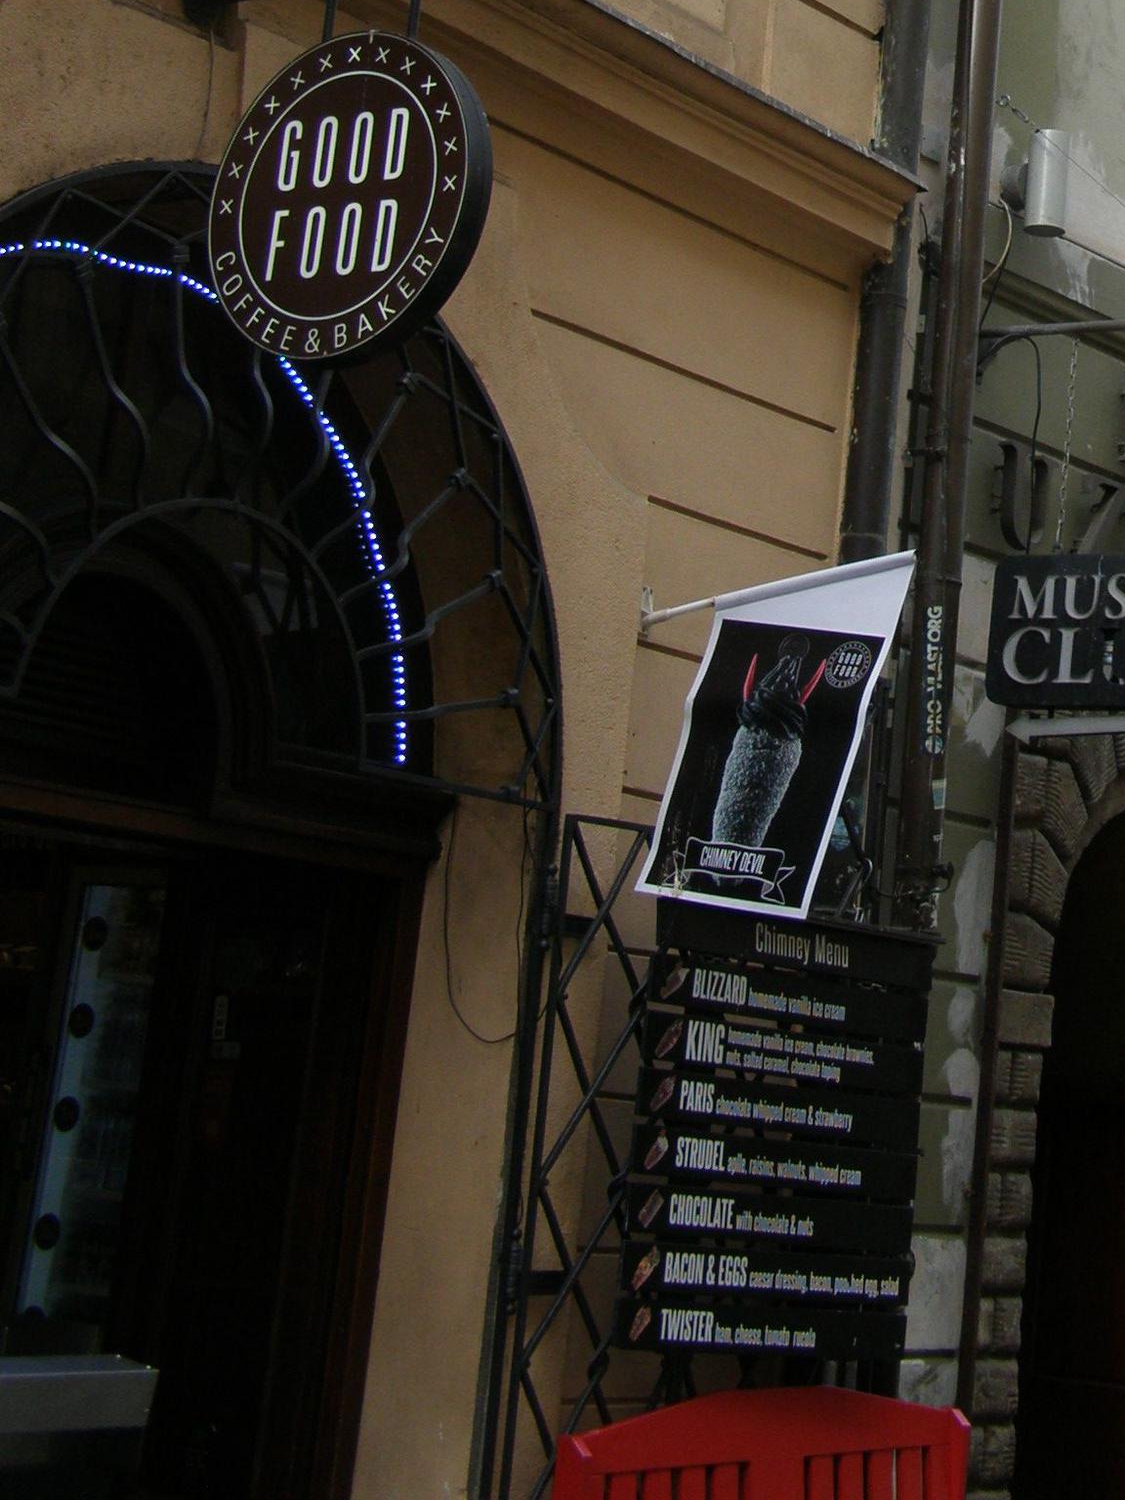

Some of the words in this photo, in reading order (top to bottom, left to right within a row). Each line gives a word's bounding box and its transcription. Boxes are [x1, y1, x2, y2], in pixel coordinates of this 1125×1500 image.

[277, 107, 411, 192] GOOD
[264, 198, 399, 282] FOOD
[215, 250, 297, 353] COFFEE
[304, 327, 322, 354] &
[333, 226, 446, 348] BAKERY
[989, 440, 1050, 552] U
[700, 845, 741, 871] CHIMNEY
[738, 852, 766, 875] DEVIL
[755, 922, 811, 965] Chimney
[814, 933, 850, 968] Menu
[692, 968, 748, 1005] BLIZZARD
[685, 1020, 726, 1065] KING
[679, 1079, 715, 1114] PARIS
[807, 1105, 814, 1126] &
[675, 1136, 725, 1171] STRUDEL
[668, 1193, 735, 1229] CHOCOLATE
[735, 1209, 753, 1230] with
[664, 1252, 704, 1284] BACON
[706, 1255, 716, 1285] &
[718, 1256, 748, 1286] EGGS
[660, 1308, 714, 1342] TWISTER
